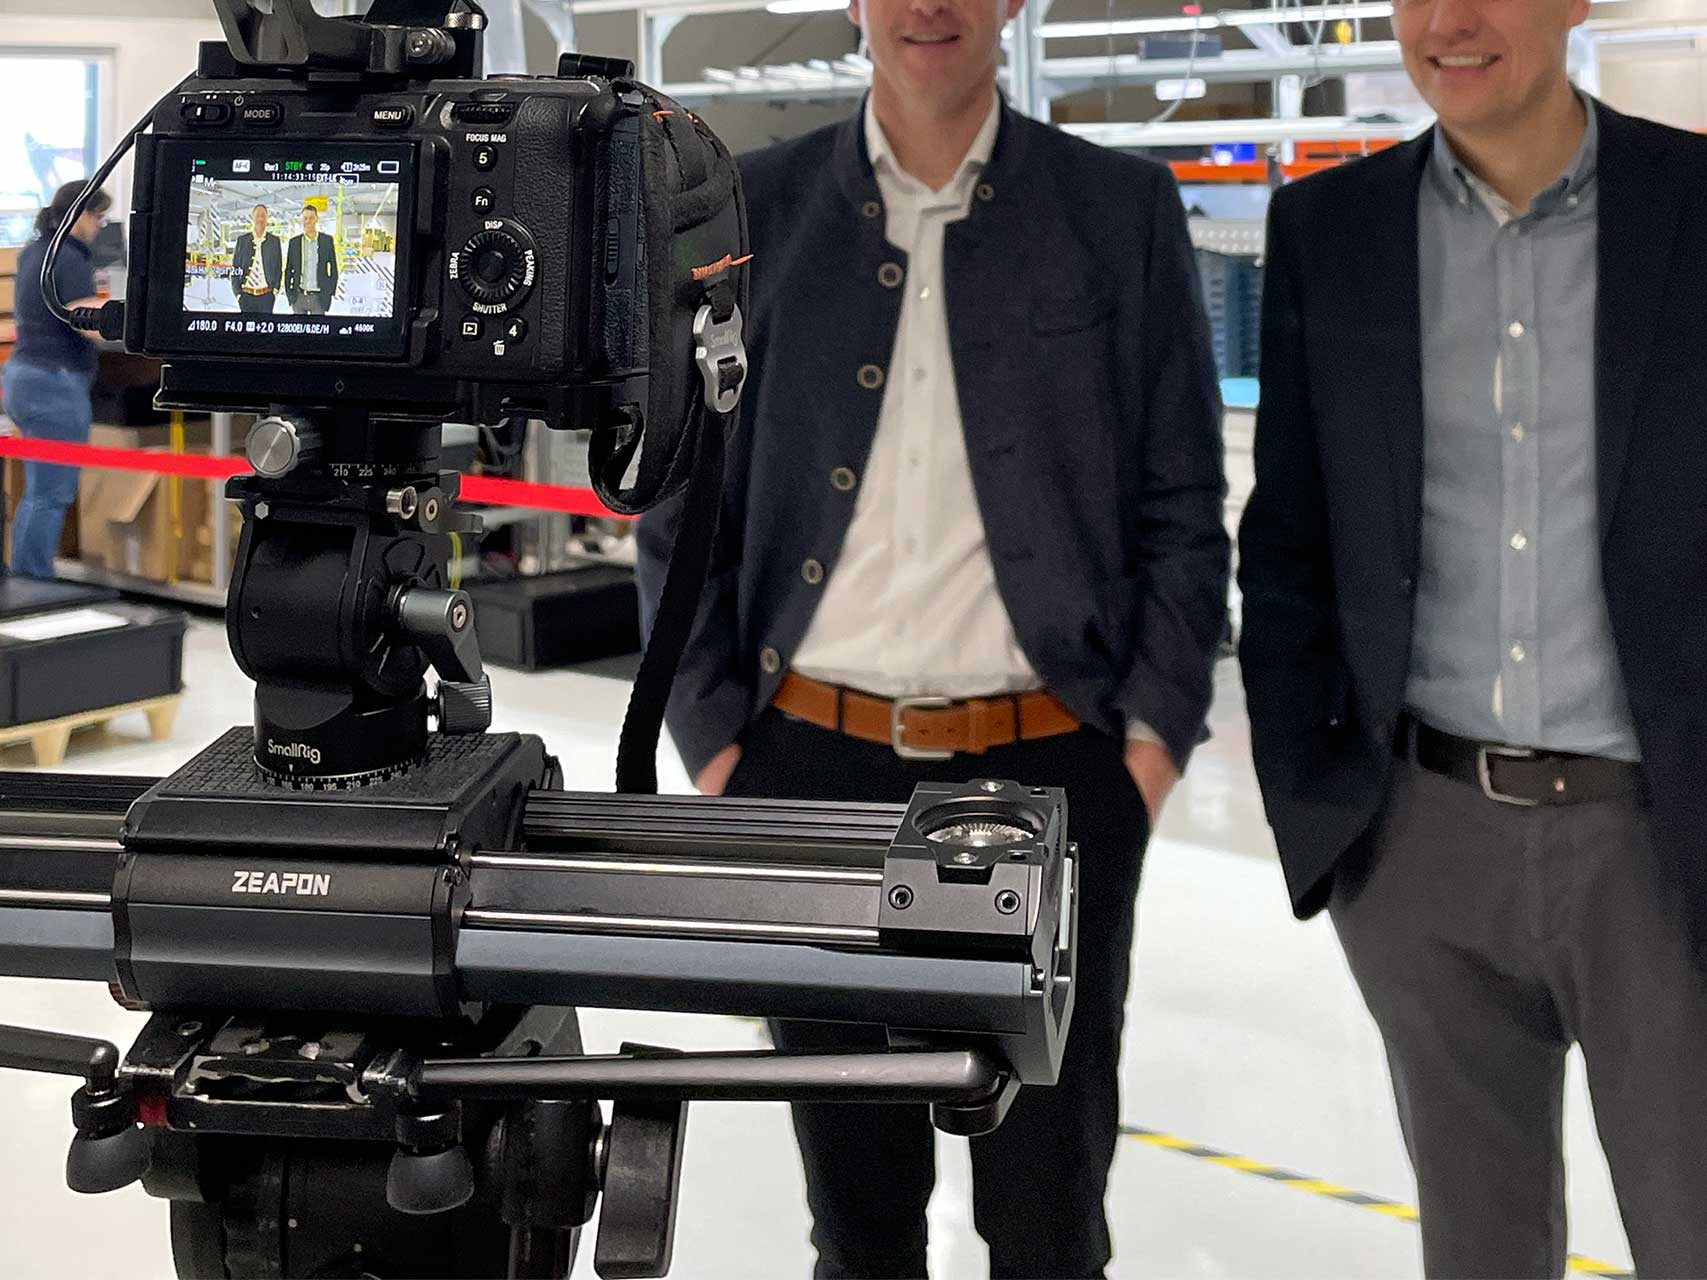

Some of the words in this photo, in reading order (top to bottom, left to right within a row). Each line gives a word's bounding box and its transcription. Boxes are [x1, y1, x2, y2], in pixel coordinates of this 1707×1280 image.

[244, 109, 271, 119] MODE
[373, 110, 402, 120] MENU
[465, 133, 490, 142] FOCUS
[490, 134, 507, 143] MAG
[478, 152, 488, 164] 5
[475, 196, 489, 207] Fn
[484, 220, 504, 230] DISP
[449, 252, 460, 280] ZEBRA
[523, 249, 535, 287] PEAKING
[472, 302, 508, 314] SHUTTER
[225, 321, 243, 332] F4.0
[508, 324, 518, 337] 4
[267, 738, 321, 764] SmallRig
[231, 871, 331, 896] ZEAPON
